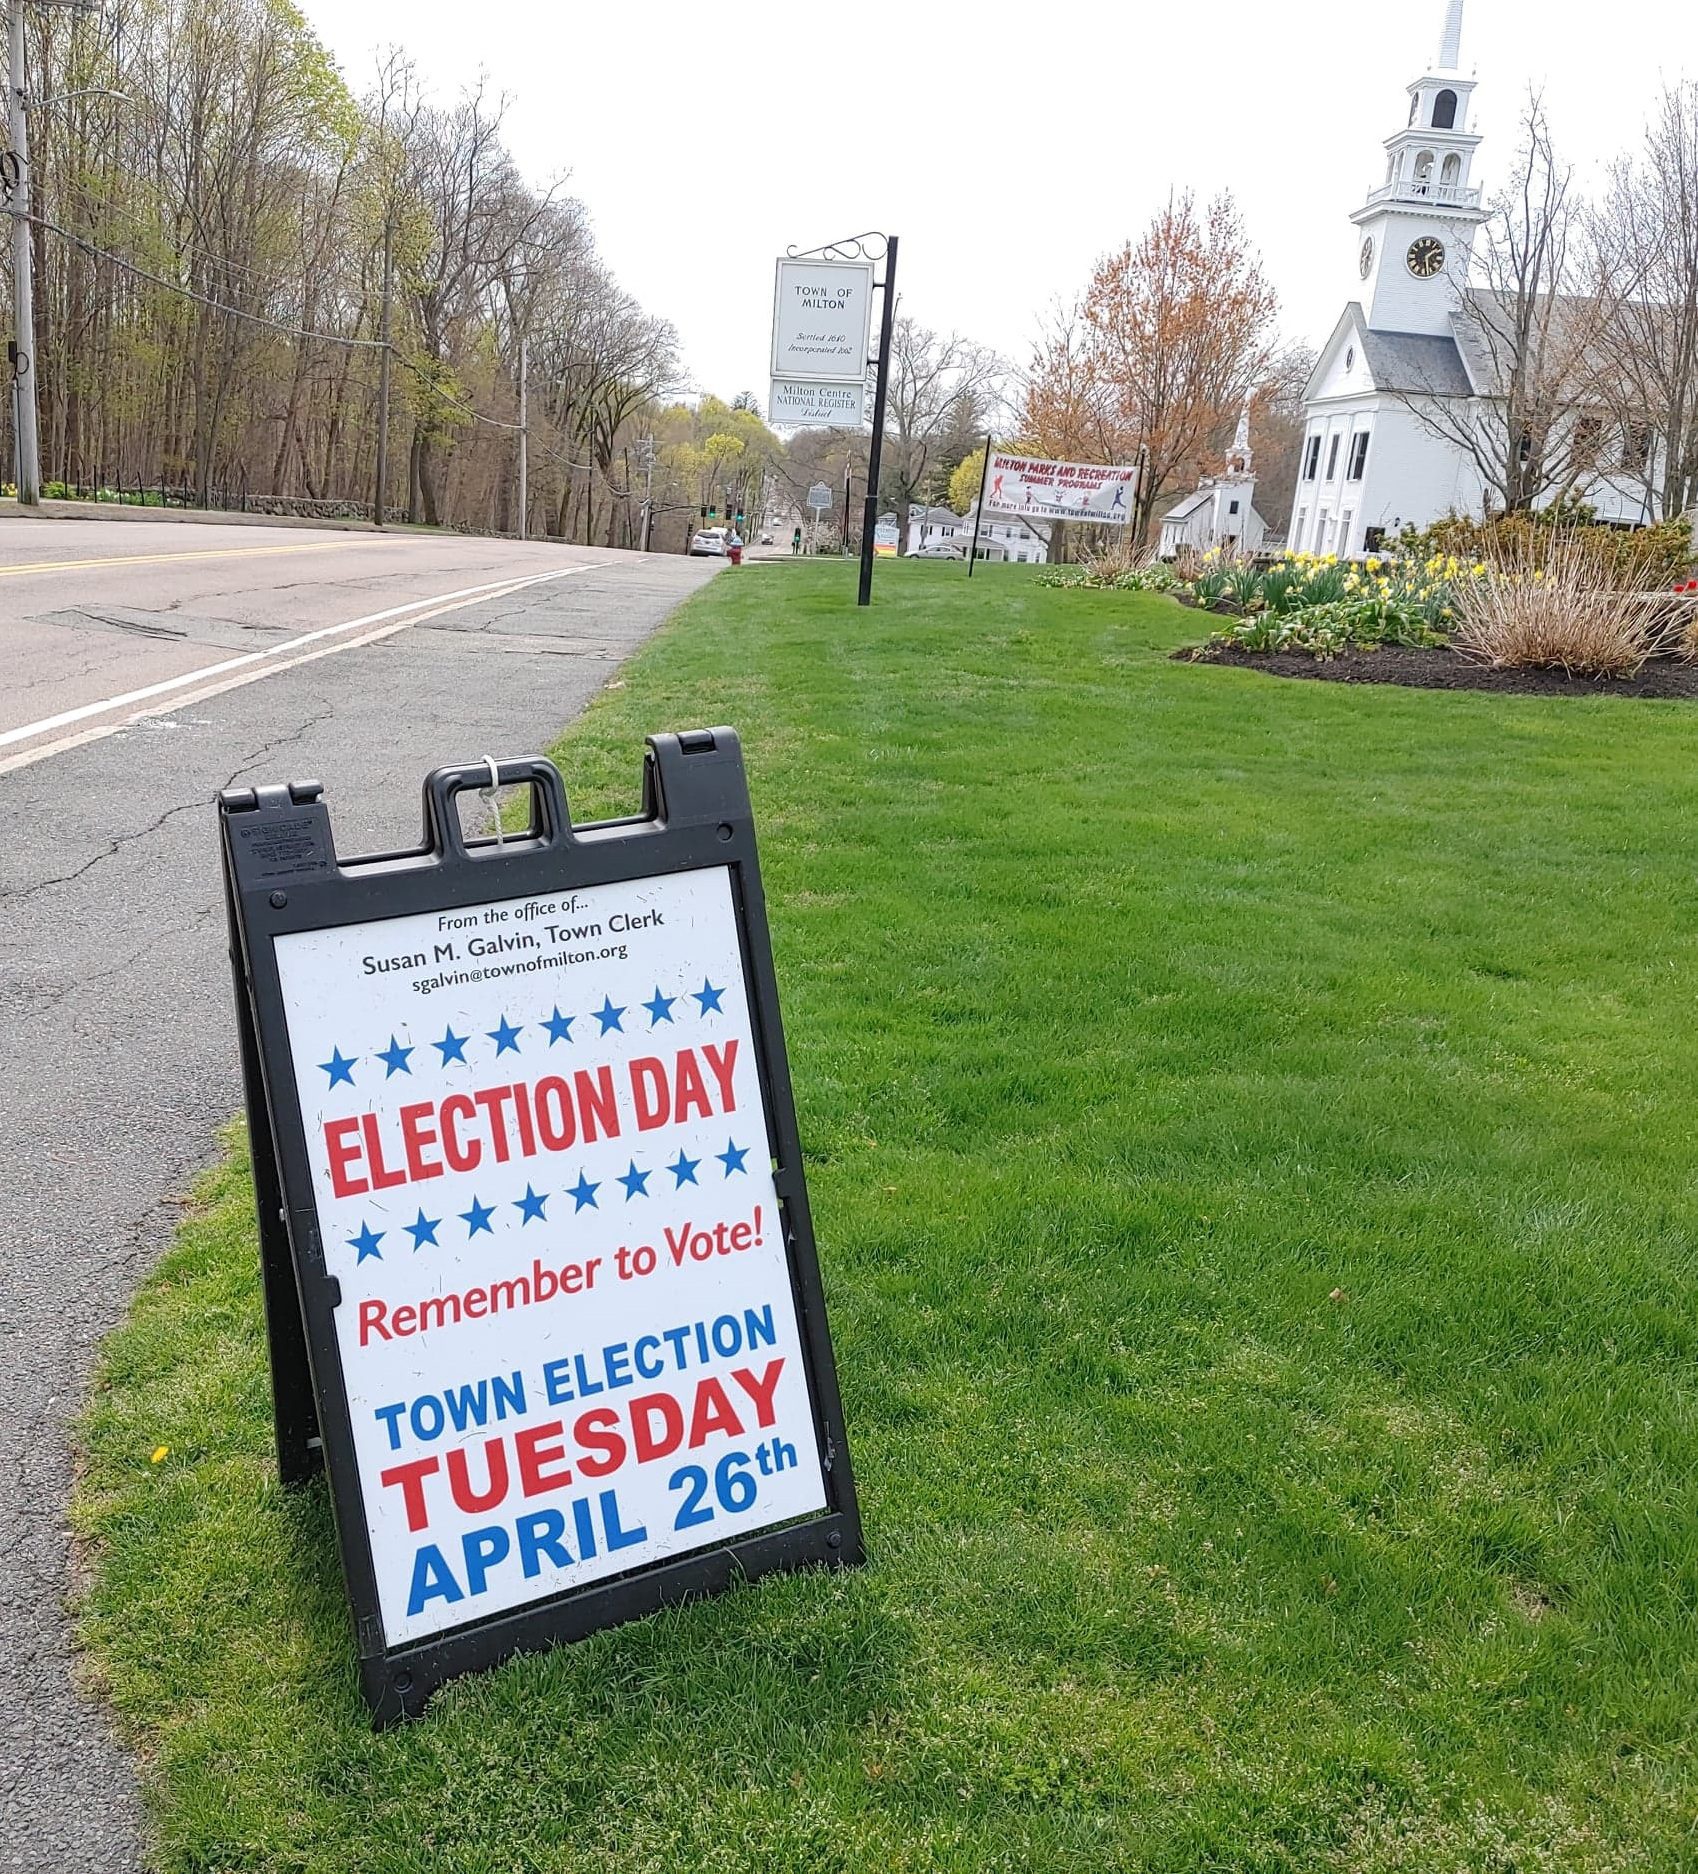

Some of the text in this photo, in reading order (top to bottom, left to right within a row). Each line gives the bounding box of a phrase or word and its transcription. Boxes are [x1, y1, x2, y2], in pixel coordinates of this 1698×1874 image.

[794, 286, 853, 298] TOWN OF
[802, 299, 845, 309] MILTON
[788, 343, 837, 354] Incorporated
[796, 332, 826, 341] Settled
[777, 395, 856, 409] NATIONAL REGISTER
[783, 385, 851, 398] Milton Centre
[994, 457, 1133, 482] MILTON PARKS AND RECREATION
[1019, 474, 1103, 490] SUMMER PROGRAMS
[989, 500, 1000, 508] For
[1001, 502, 1017, 510] more
[1018, 503, 1030, 511] info
[1031, 505, 1039, 513] go
[438, 895, 589, 932] From the office of...
[362, 909, 665, 975] Susan M. Galvin, Town Clerk
[412, 944, 629, 995] sgalvin@townofmilton.org
[323, 1039, 739, 1198] ELECTION DAY
[359, 1205, 763, 1346] Remember to Vote!
[374, 1304, 777, 1451] TOWN ELECTION
[381, 1357, 786, 1533] TUESDAY
[406, 1437, 798, 1617] APRIL 26th
